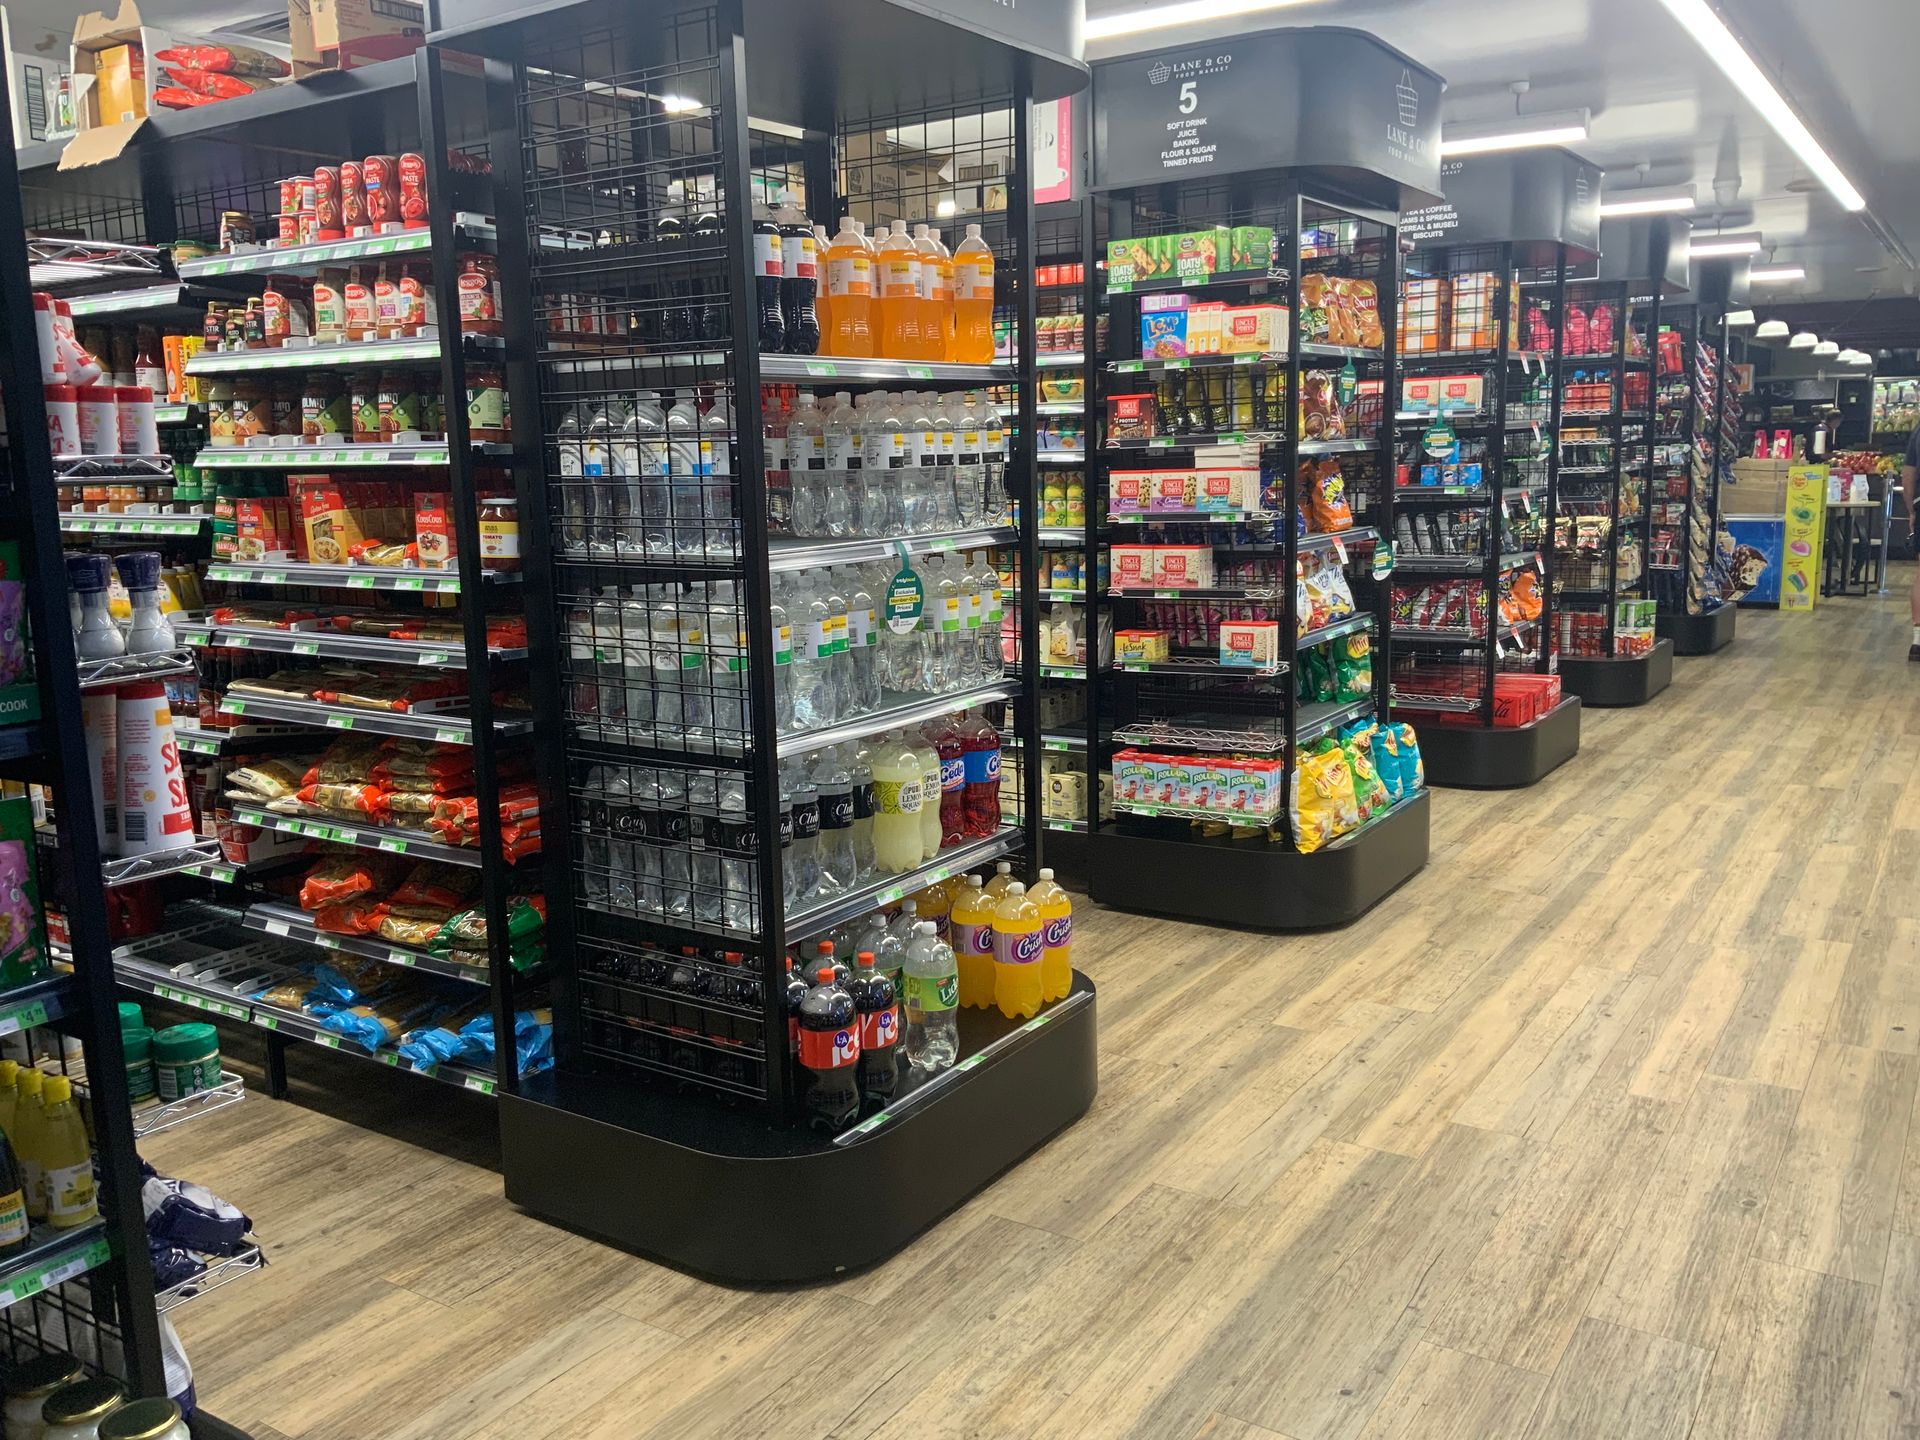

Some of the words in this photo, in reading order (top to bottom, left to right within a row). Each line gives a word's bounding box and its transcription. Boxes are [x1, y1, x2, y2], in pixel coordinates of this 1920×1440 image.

[1174, 60, 1201, 72] LANE
[1205, 58, 1212, 67] &
[1216, 54, 1232, 64] CO
[1176, 71, 1195, 79] FOOD
[1198, 65, 1228, 75] MARKET
[1178, 81, 1198, 114] 5
[1166, 120, 1184, 130] SOFT
[1186, 117, 1208, 128] DRINK
[1177, 128, 1198, 138] JUICE
[1387, 124, 1408, 147] LANE
[1172, 138, 1200, 148] BAKING
[1161, 149, 1184, 159] FLOUR
[1192, 144, 1216, 155] SUGAR
[1162, 158, 1188, 168] TINNED
[1188, 154, 1214, 164] FRUITS
[1450, 162, 1462, 170] CO
[1426, 204, 1452, 214] COFFEE
[1400, 216, 1418, 224] JAMS
[1426, 212, 1458, 222] SPREADS
[1400, 224, 1426, 232] CEREAL
[1432, 220, 1458, 229] MUSELI
[1413, 230, 1444, 240] BISCUITS
[1180, 256, 1200, 270] OATY
[1113, 264, 1132, 276] OATY
[1177, 268, 1200, 278] SLICES
[0, 699, 28, 712] COOK
[798, 810, 818, 826] Club
[780, 820, 792, 833] lub
[1047, 918, 1072, 943] Crush
[1018, 934, 1044, 959] Crush
